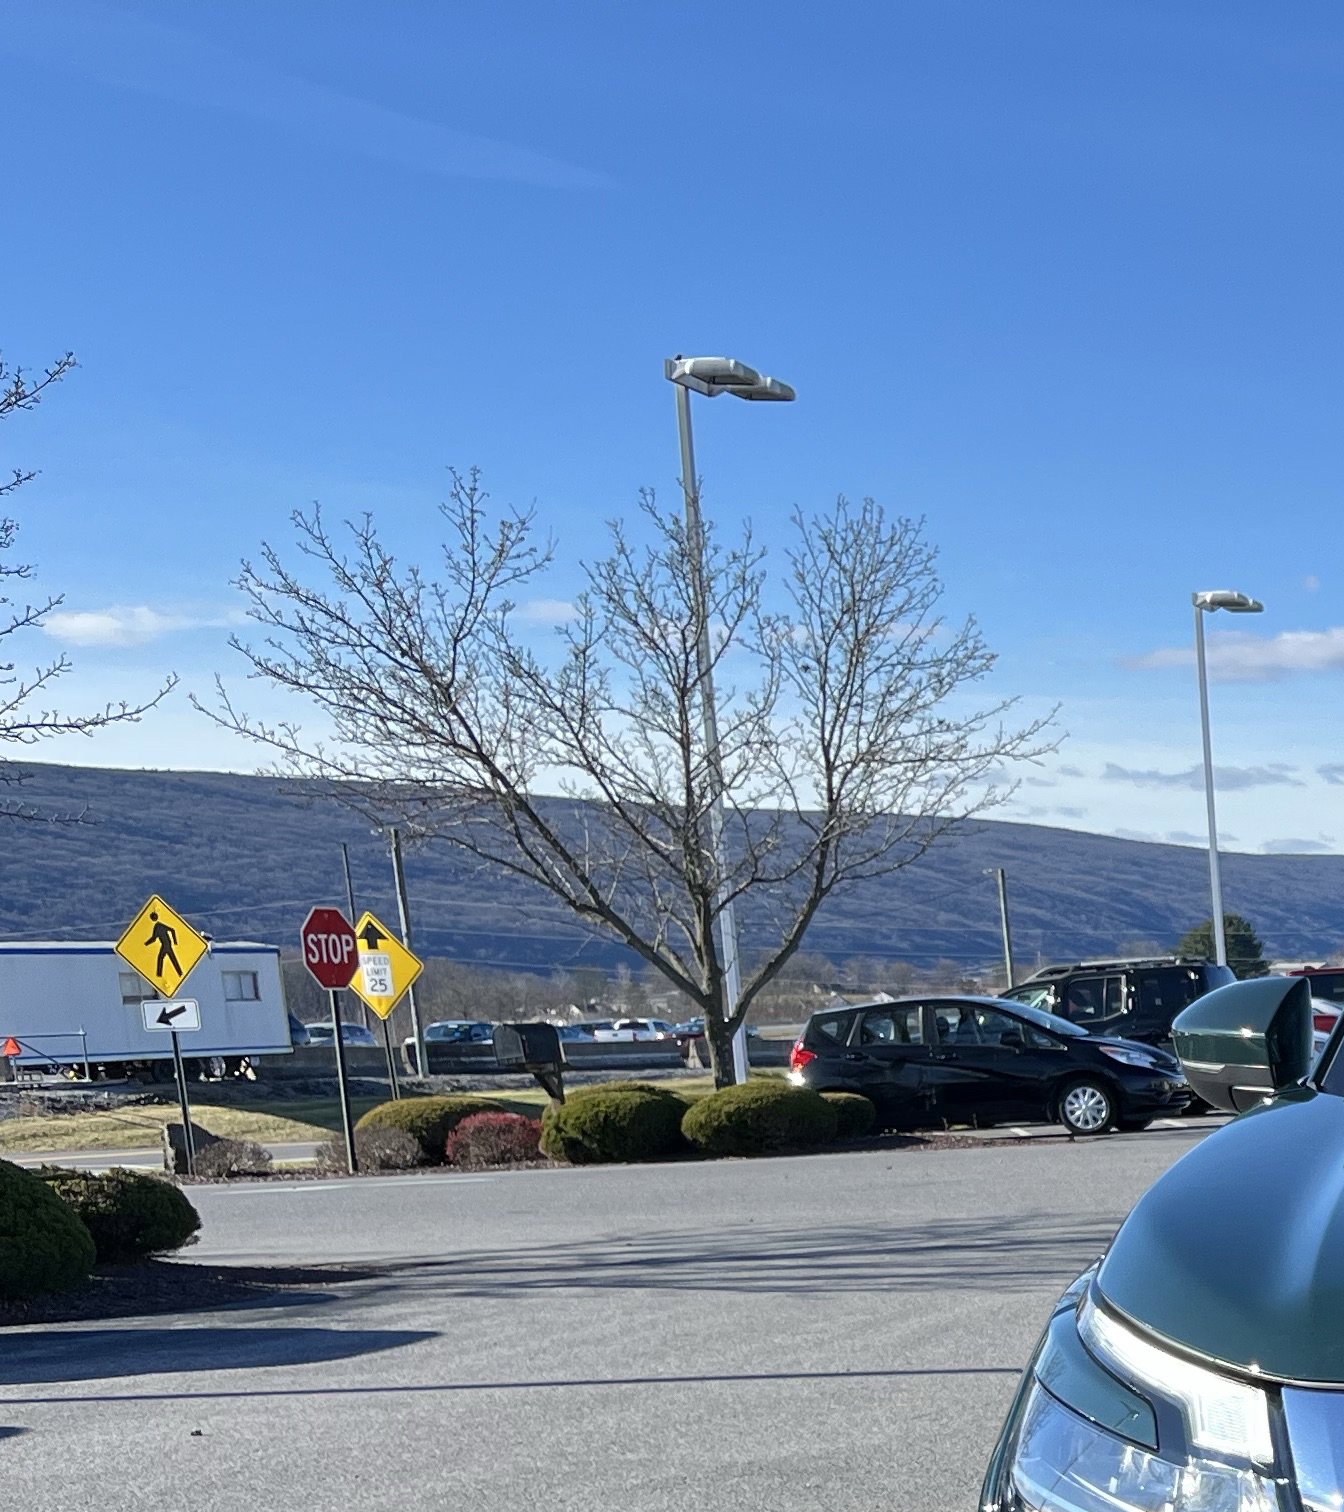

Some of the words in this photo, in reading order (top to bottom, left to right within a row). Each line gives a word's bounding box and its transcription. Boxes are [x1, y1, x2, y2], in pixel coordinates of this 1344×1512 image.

[306, 933, 354, 964] STOP
[362, 956, 390, 966] SPEED
[366, 967, 388, 977] LIMIT
[369, 978, 388, 993] 25
